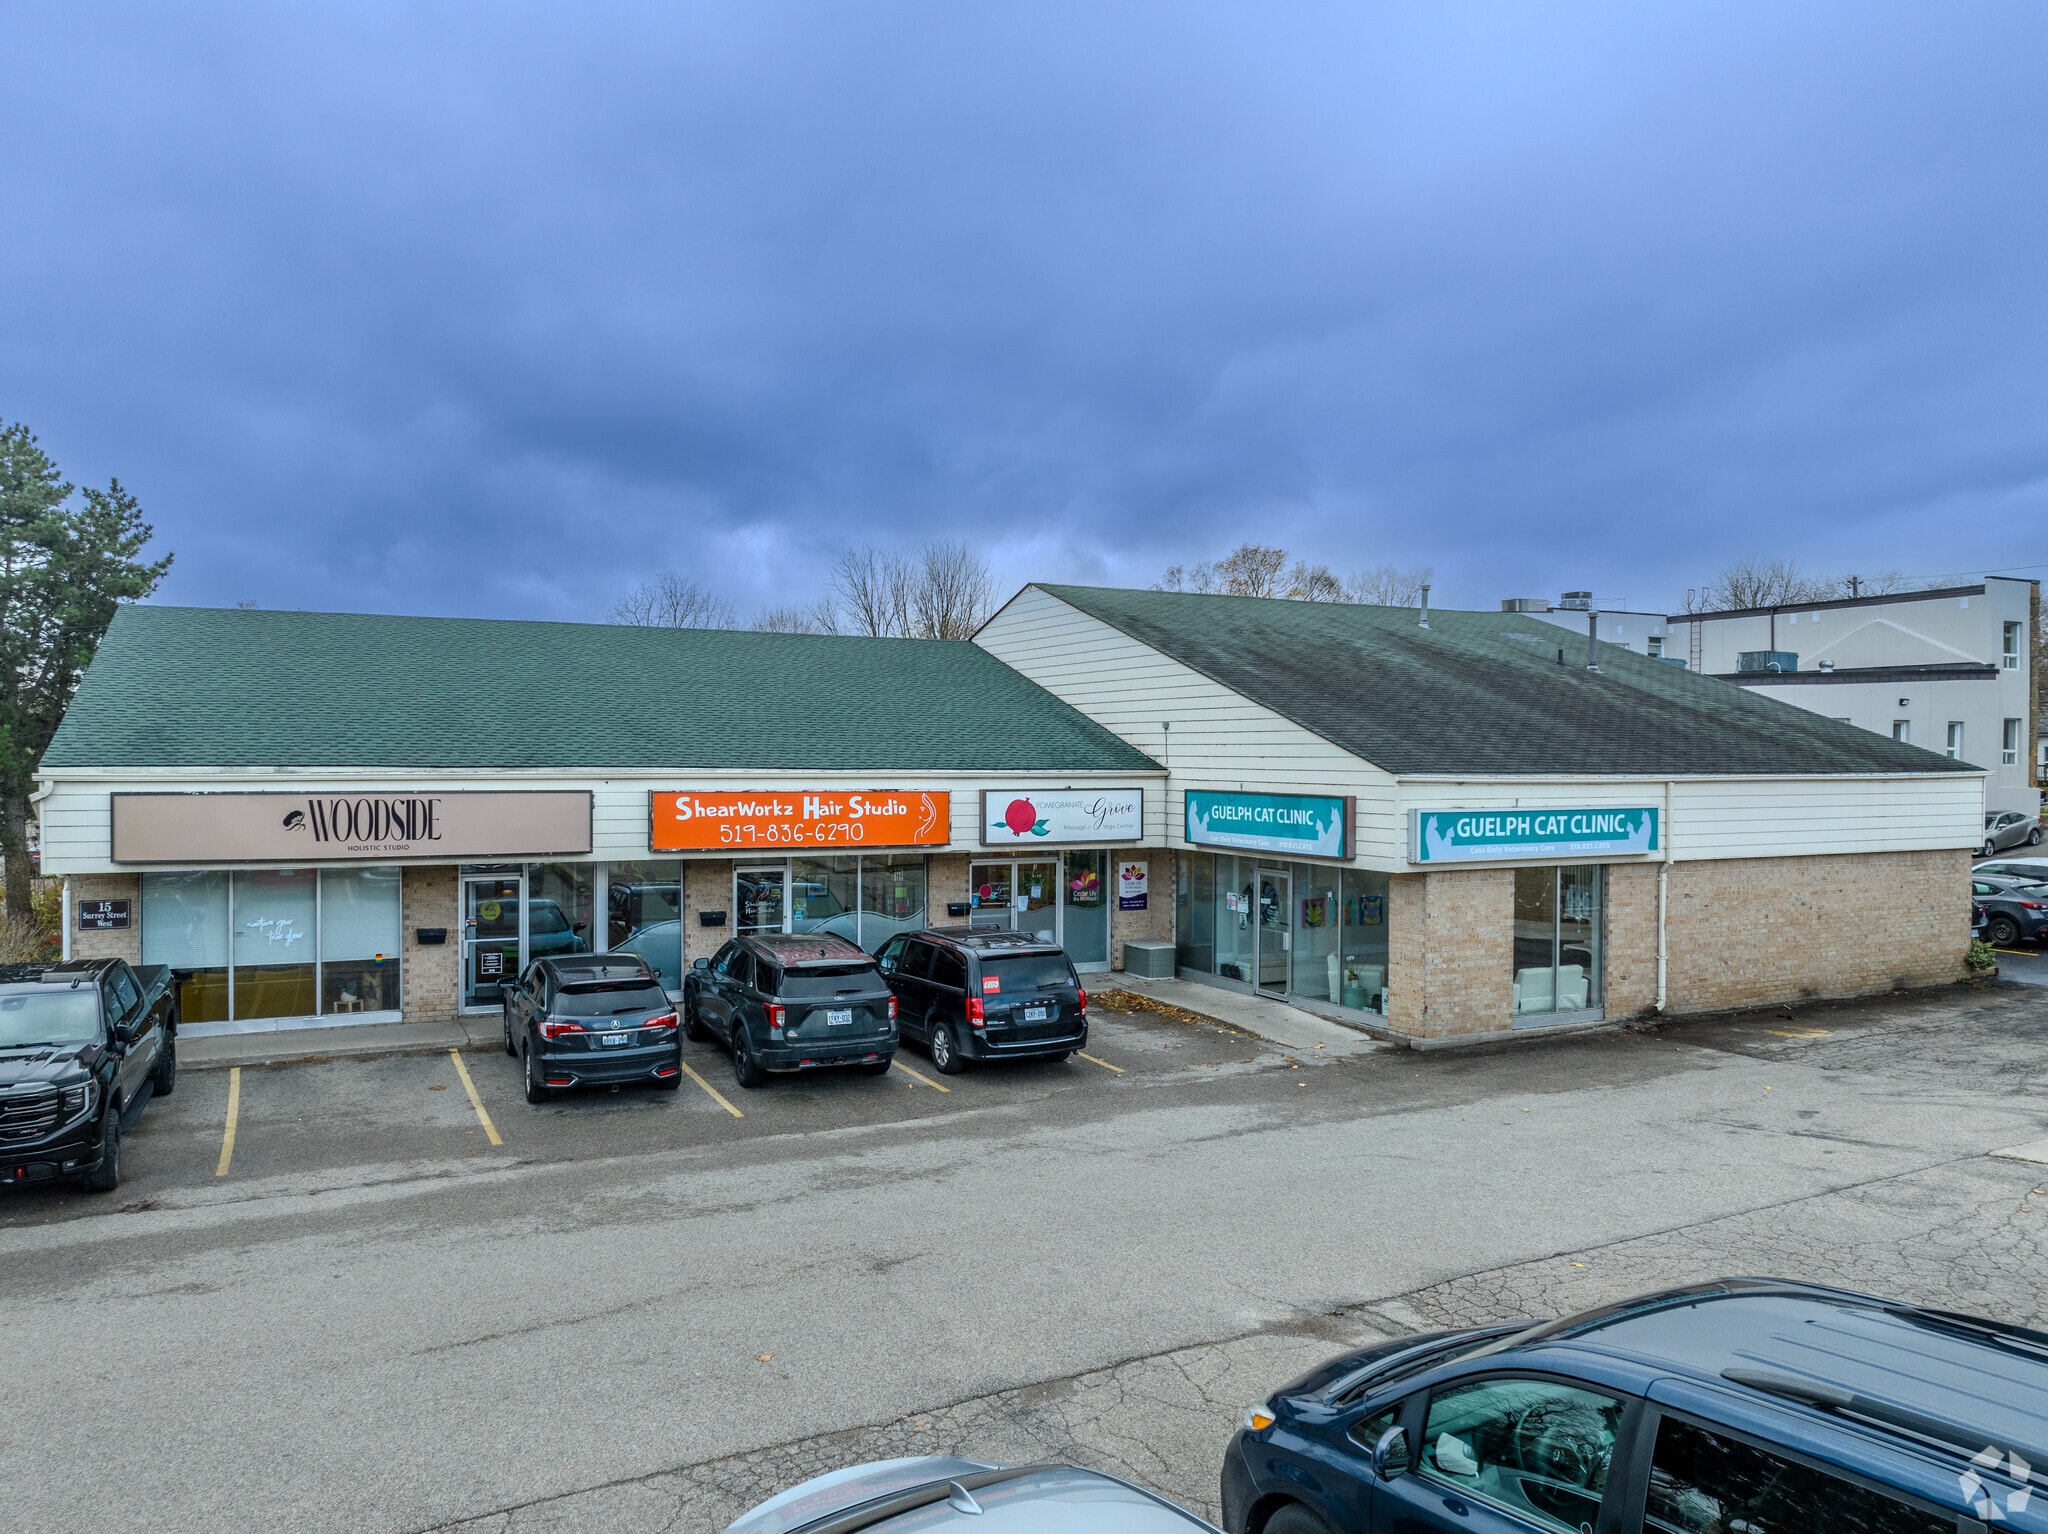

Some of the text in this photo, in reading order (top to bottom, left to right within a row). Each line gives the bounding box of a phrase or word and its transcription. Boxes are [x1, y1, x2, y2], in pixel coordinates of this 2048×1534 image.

[675, 796, 907, 821] ShearWorkz Hair Studio
[1036, 797, 1135, 830] POMEGRANATE Grove
[1211, 805, 1314, 826] GUELPH CAT CLINIC
[308, 799, 442, 842] WOODSIDE
[1456, 813, 1626, 838] GUELPH CAT CLINIC
[720, 823, 864, 843] 519-836-6290
[347, 844, 381, 852] HOLISTIC
[1220, 836, 1231, 844] Only
[1231, 837, 1257, 846] Veterinary
[1257, 839, 1269, 847] Care
[1470, 844, 1556, 855] Cats Only Veterinary Care
[98, 901, 112, 912] 15
[82, 911, 127, 920] Surrey Street
[97, 919, 113, 927] West
